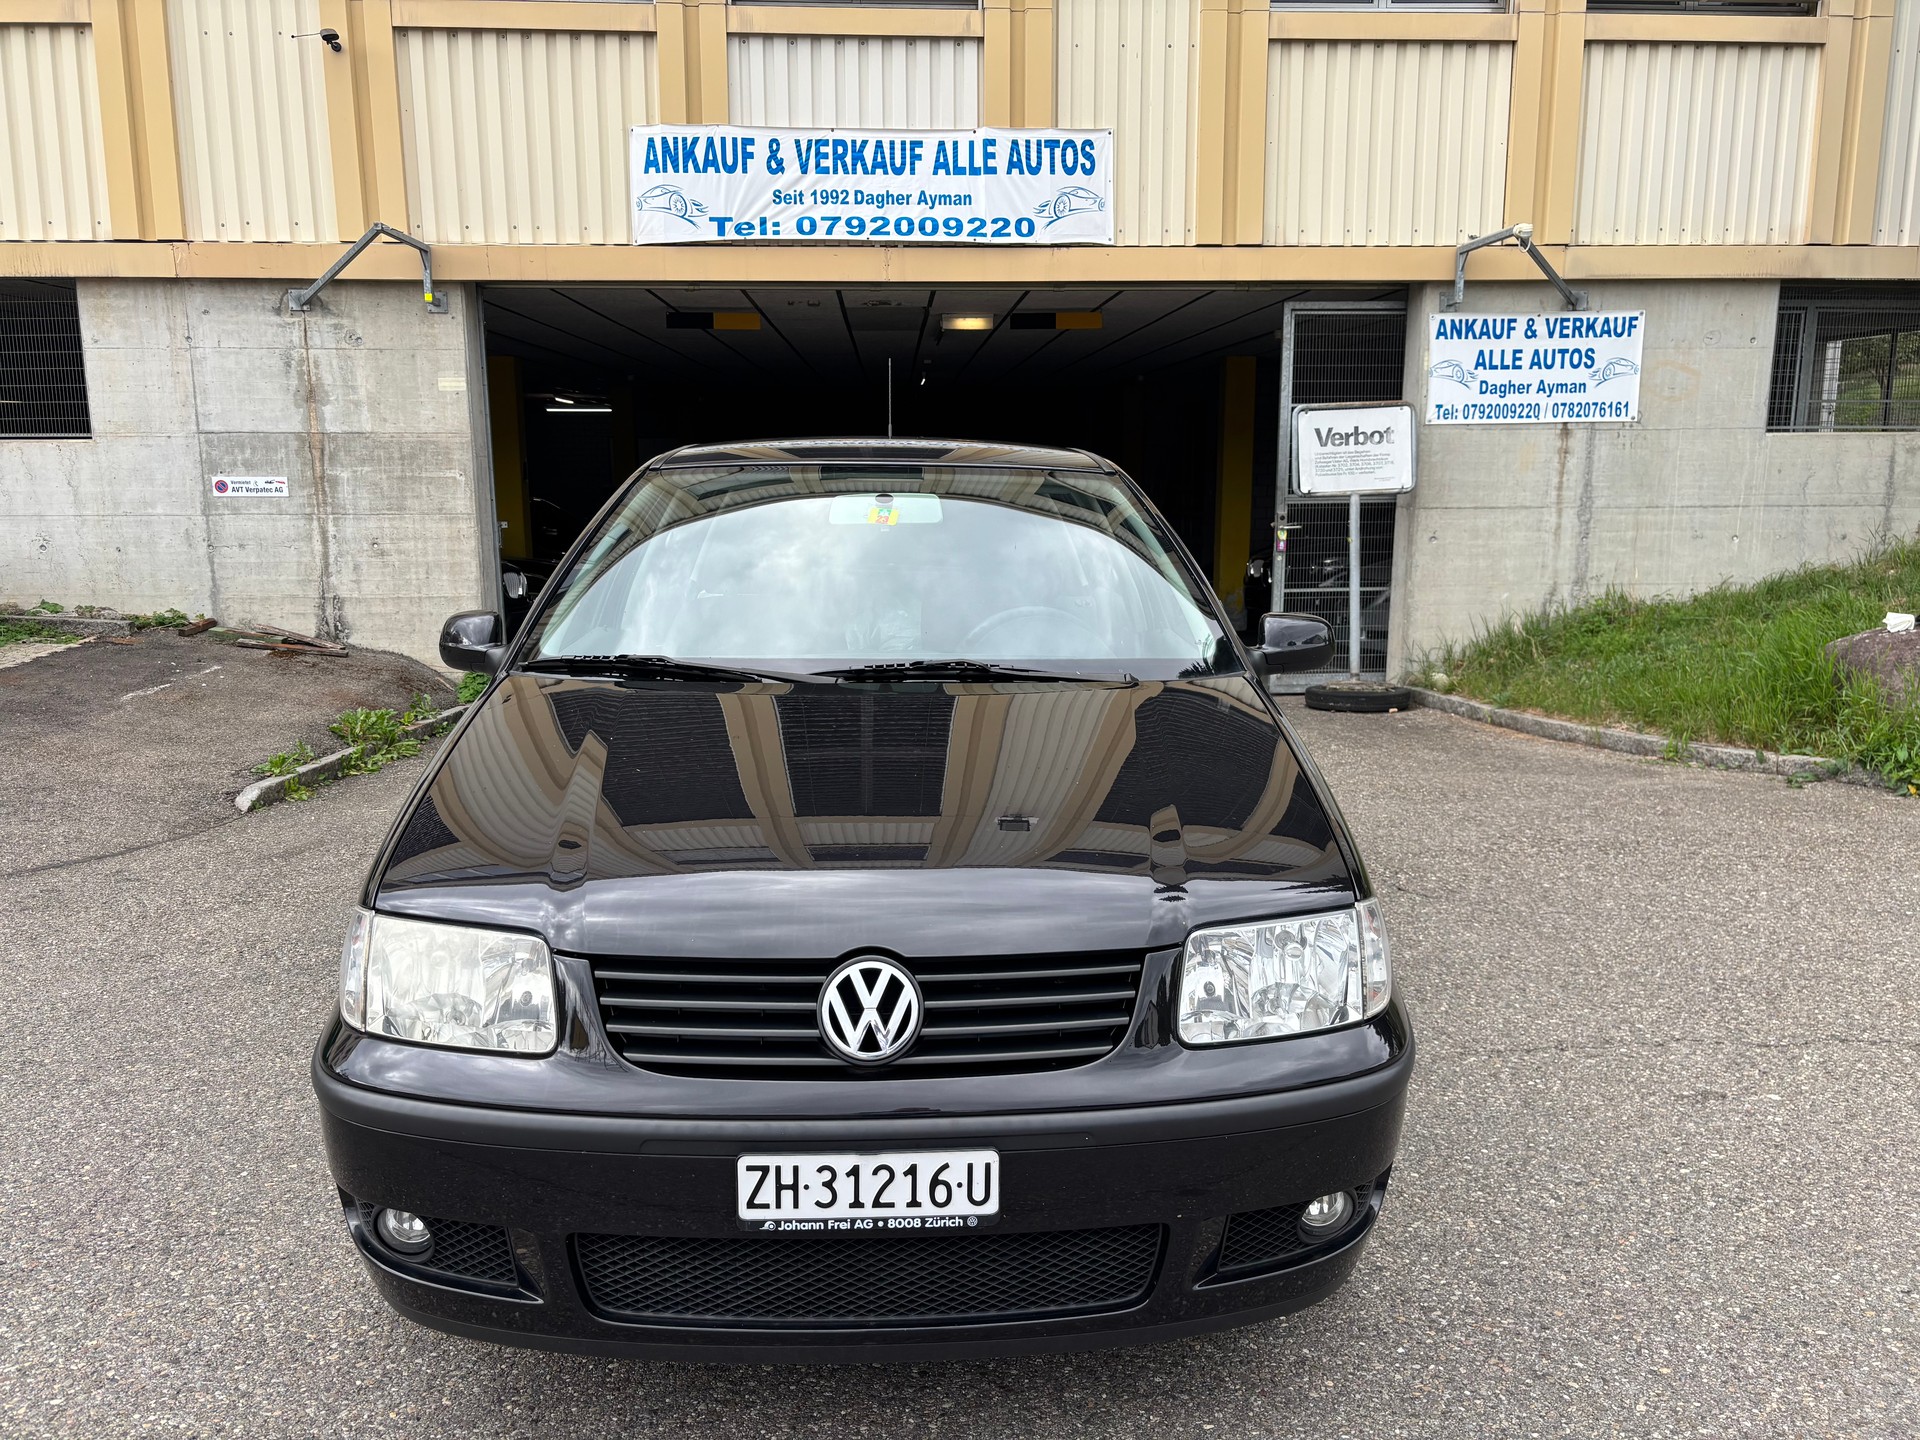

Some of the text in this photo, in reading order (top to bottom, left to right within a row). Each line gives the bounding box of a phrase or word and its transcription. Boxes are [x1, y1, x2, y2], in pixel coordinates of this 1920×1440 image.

[644, 136, 1096, 176] ANKAUF & VERKAUF ALLE AUTOS
[773, 189, 972, 209] Seit 1992 Dagher Ayman
[709, 216, 1036, 238] Tel: 0792009220
[1435, 317, 1639, 340] ANKAUF & VERKAUF
[1474, 348, 1596, 370] ALLE AUTOS
[1479, 380, 1587, 398] Dagher Ayman
[1435, 404, 1458, 420] Tel:
[1463, 404, 1540, 420] 0792009220
[1552, 402, 1629, 418] 0782076161
[1314, 426, 1394, 447] Verbot
[245, 486, 273, 494] Verpatec
[778, 1220, 824, 1231] Johann
[828, 1220, 851, 1230] Frei
[855, 1219, 873, 1229] AG
[888, 1218, 921, 1228] 8008
[925, 1216, 963, 1228] Zürich
